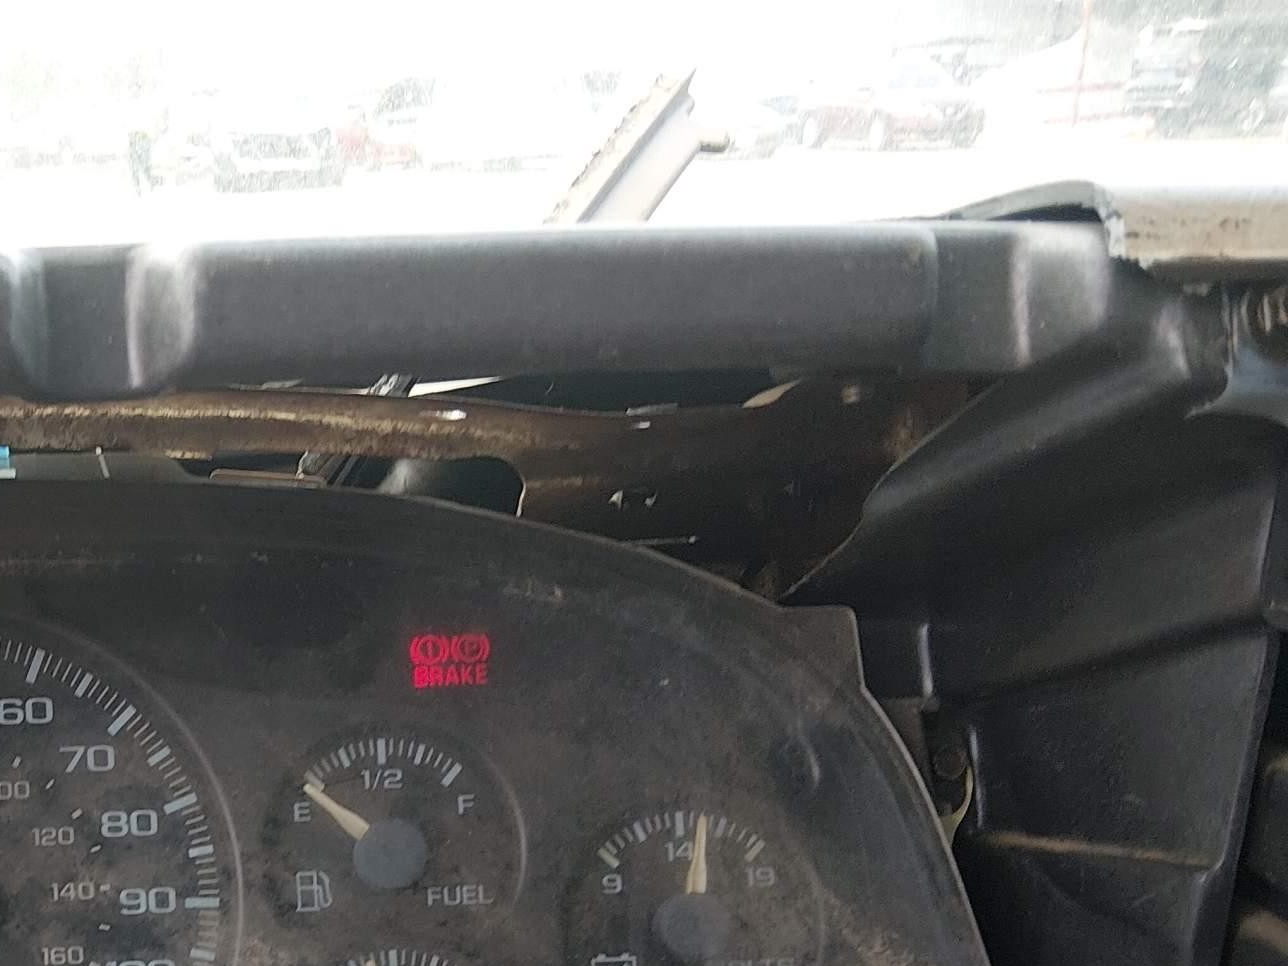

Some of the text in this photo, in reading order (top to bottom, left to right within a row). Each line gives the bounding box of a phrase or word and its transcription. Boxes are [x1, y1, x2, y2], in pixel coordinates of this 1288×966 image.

[414, 664, 488, 688] BRAKE
[59, 744, 116, 773] 70
[361, 768, 403, 790] 1/2
[294, 802, 311, 823] E
[457, 794, 475, 815] F
[100, 809, 158, 838] 80
[32, 826, 75, 846] 120
[601, 873, 623, 894] 9
[745, 866, 775, 888] 19
[50, 882, 95, 902] 140
[119, 887, 177, 915] 90
[427, 885, 493, 906] FUEL
[42, 946, 85, 966] 160
